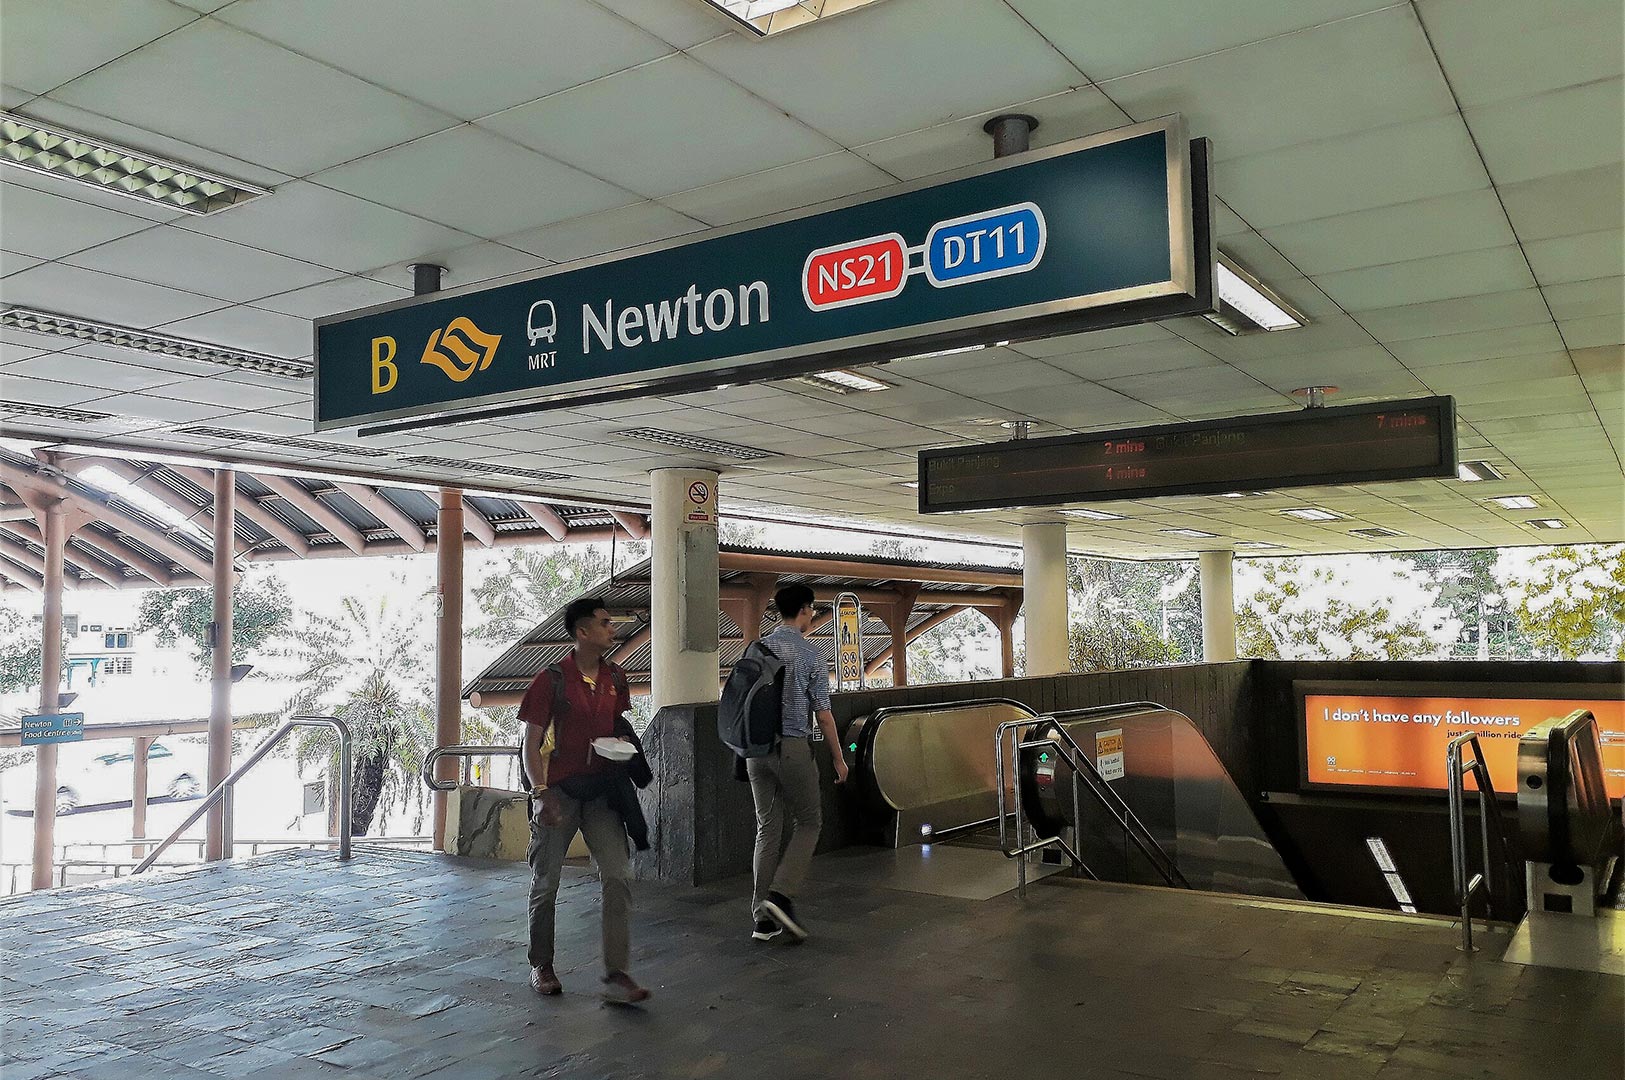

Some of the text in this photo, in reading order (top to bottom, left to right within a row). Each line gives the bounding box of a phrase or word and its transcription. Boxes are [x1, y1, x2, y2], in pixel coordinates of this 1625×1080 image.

[817, 221, 1025, 295] NS21 DT11
[581, 279, 770, 355] Newton
[371, 335, 398, 396] B
[528, 351, 557, 371] MRT
[1376, 413, 1427, 430] 7 mins
[1104, 439, 1145, 454] 2 mins
[1105, 466, 1146, 480] 4 mins
[24, 720, 52, 728] Newton
[1324, 708, 1521, 727] I don't have any followers
[24, 731, 42, 739] Food
[1447, 729, 1462, 739] just
[1503, 731, 1523, 739] ride
